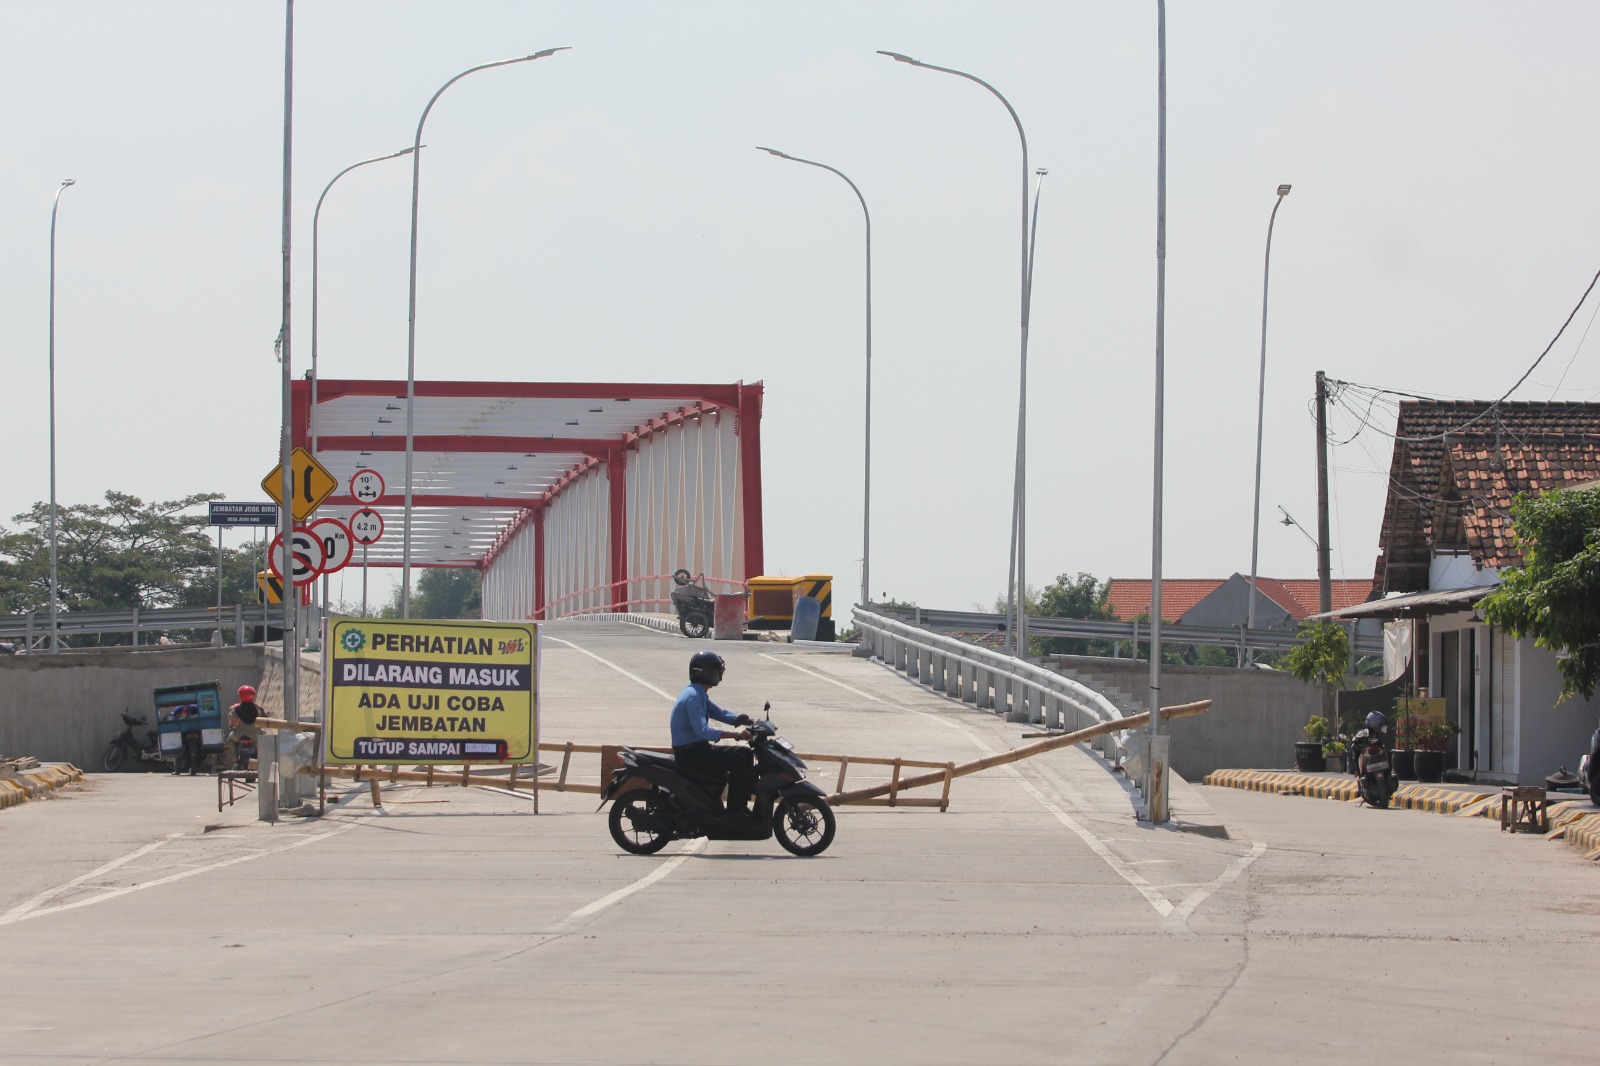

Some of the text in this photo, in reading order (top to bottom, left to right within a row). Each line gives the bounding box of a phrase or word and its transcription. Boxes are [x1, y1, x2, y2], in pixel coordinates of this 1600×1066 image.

[356, 522, 368, 531] 4.2
[334, 532, 345, 540] Km
[372, 633, 493, 656] PERHATIAN
[343, 663, 520, 686] DILARANG MASUK
[358, 693, 505, 712] ADA UJI COBA
[376, 715, 486, 732] JEMBATAN
[359, 741, 405, 754] TUTUP
[408, 742, 461, 755] SAMPAI
